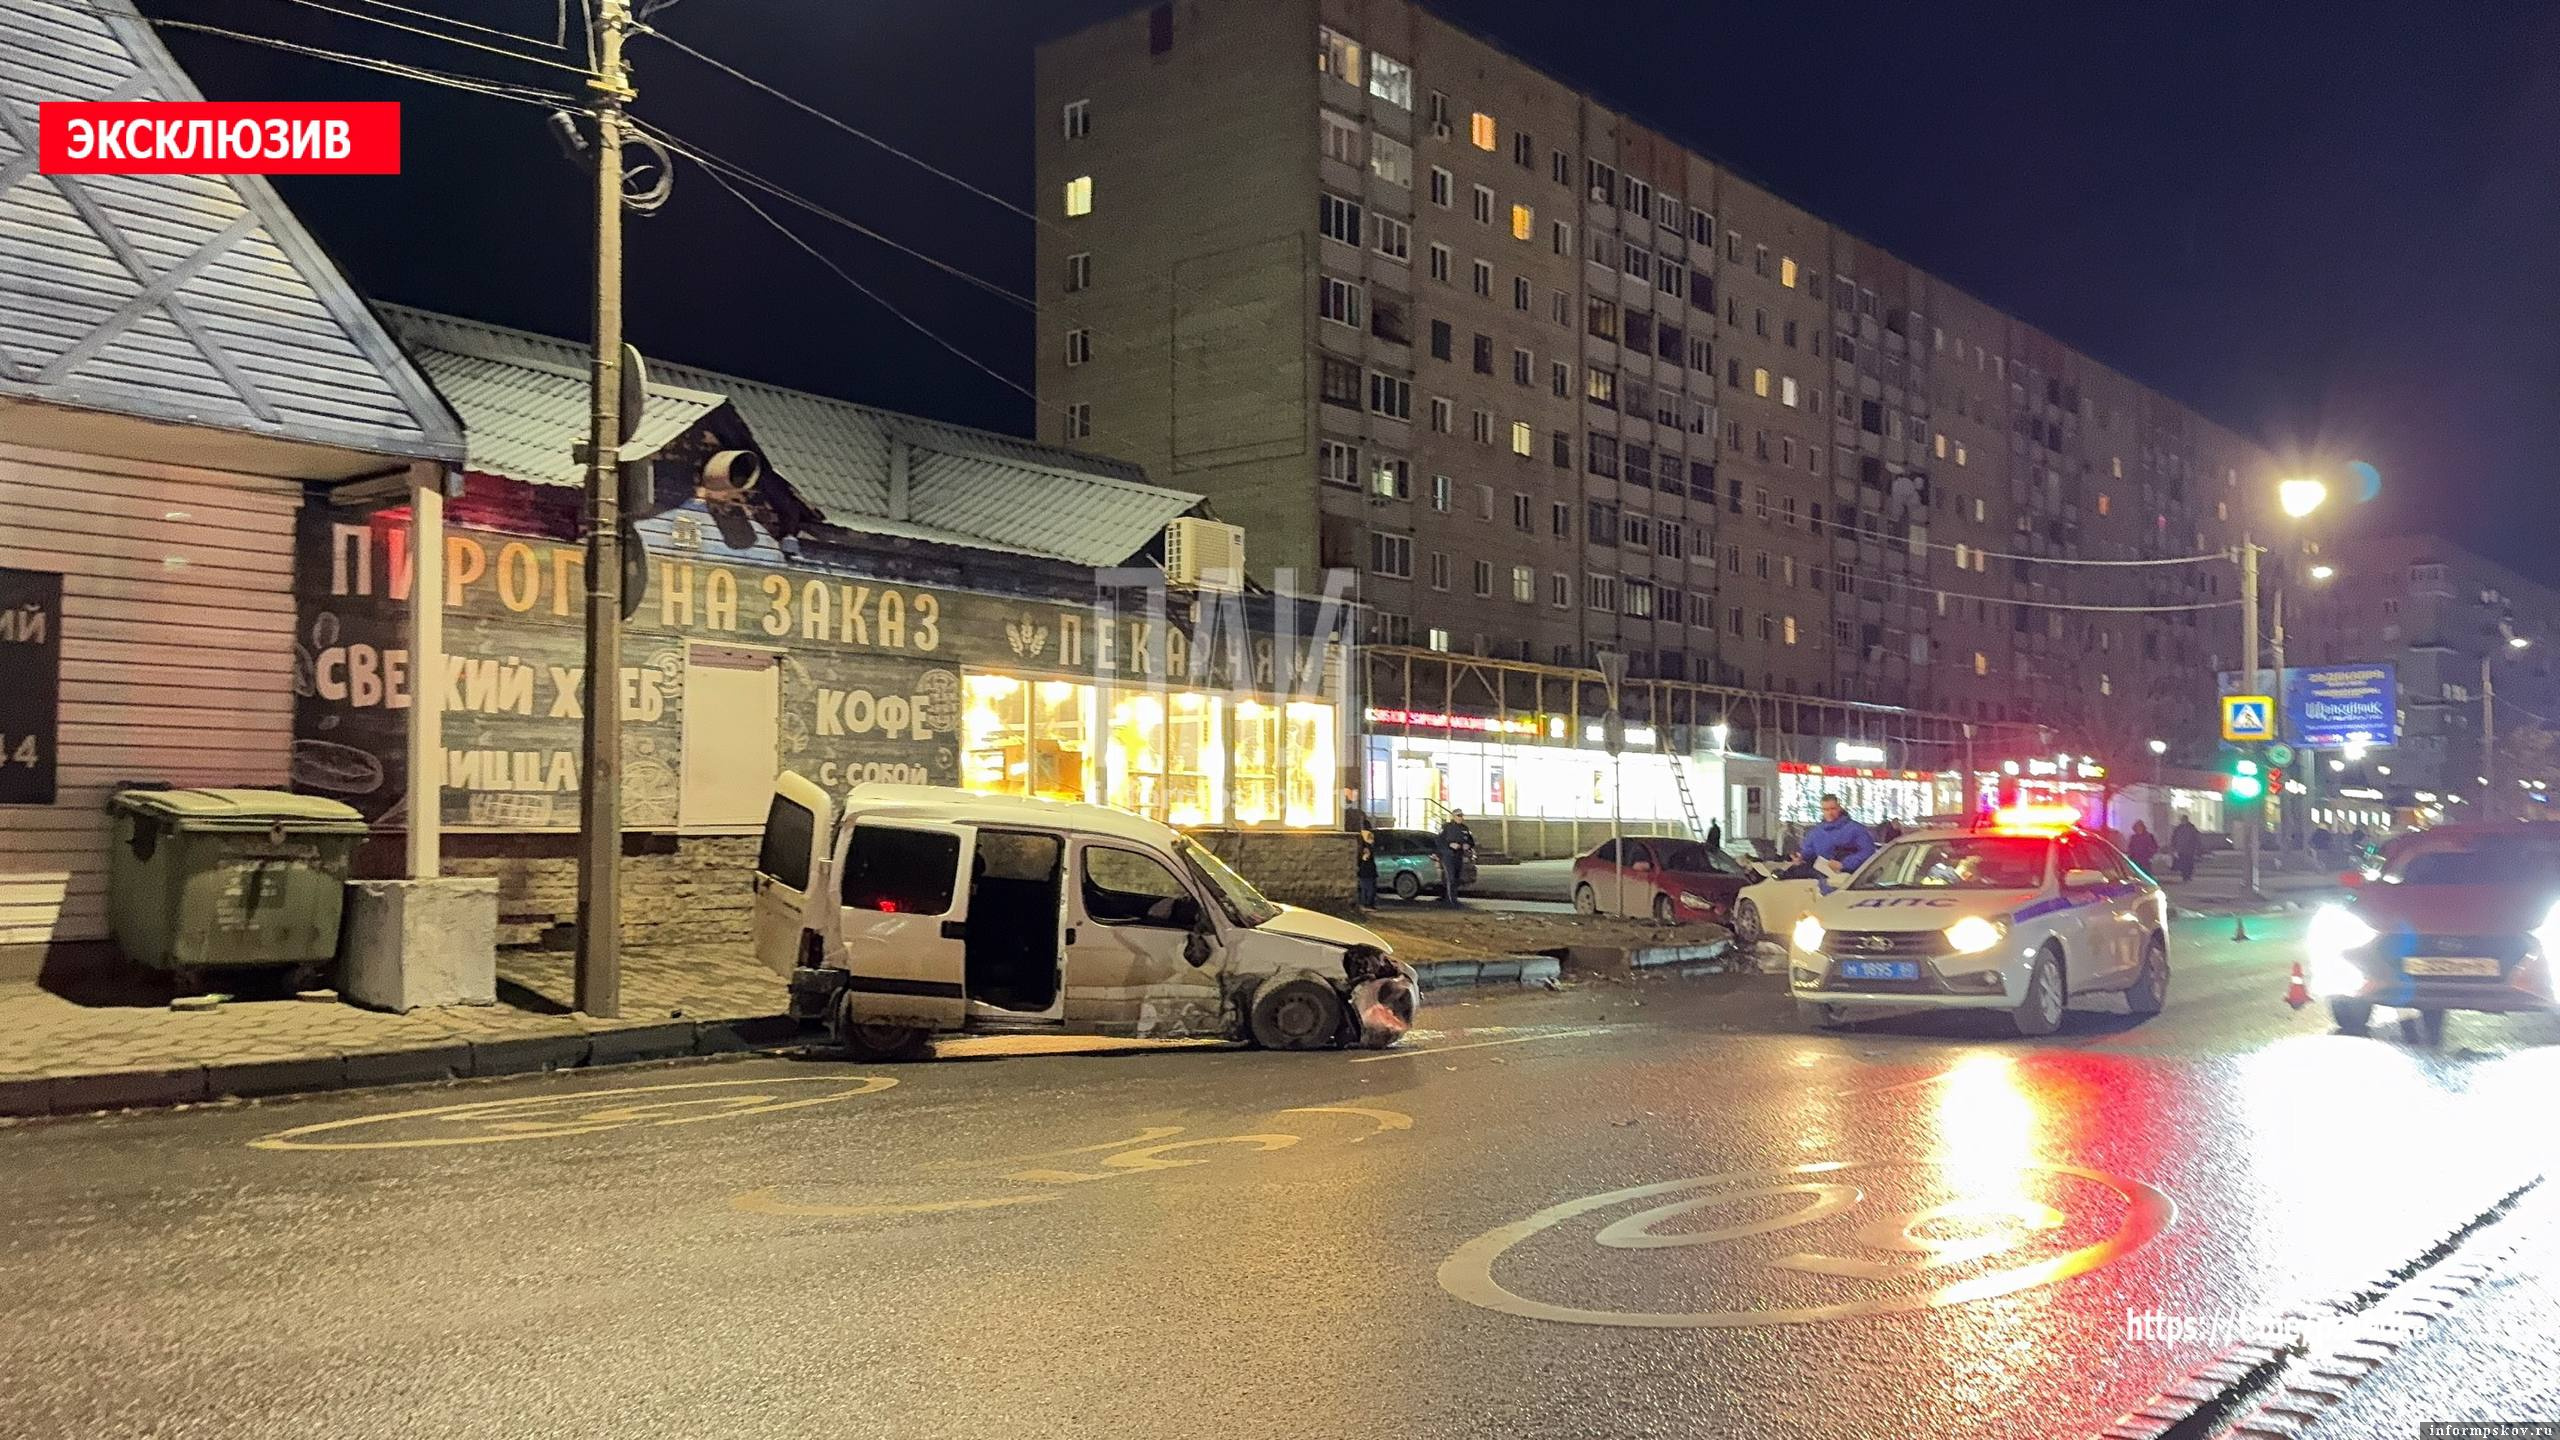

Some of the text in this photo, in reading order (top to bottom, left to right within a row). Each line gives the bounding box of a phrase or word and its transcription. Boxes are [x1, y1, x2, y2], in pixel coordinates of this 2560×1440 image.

[332, 523, 940, 652] ПИРОГ НА ЗАКАЗ
[548, 665, 664, 722] ХЕБ
[815, 688, 934, 741] КОФЕ
[846, 761, 928, 786] СОБОЙ
[1848, 897, 1960, 910] ДПС
